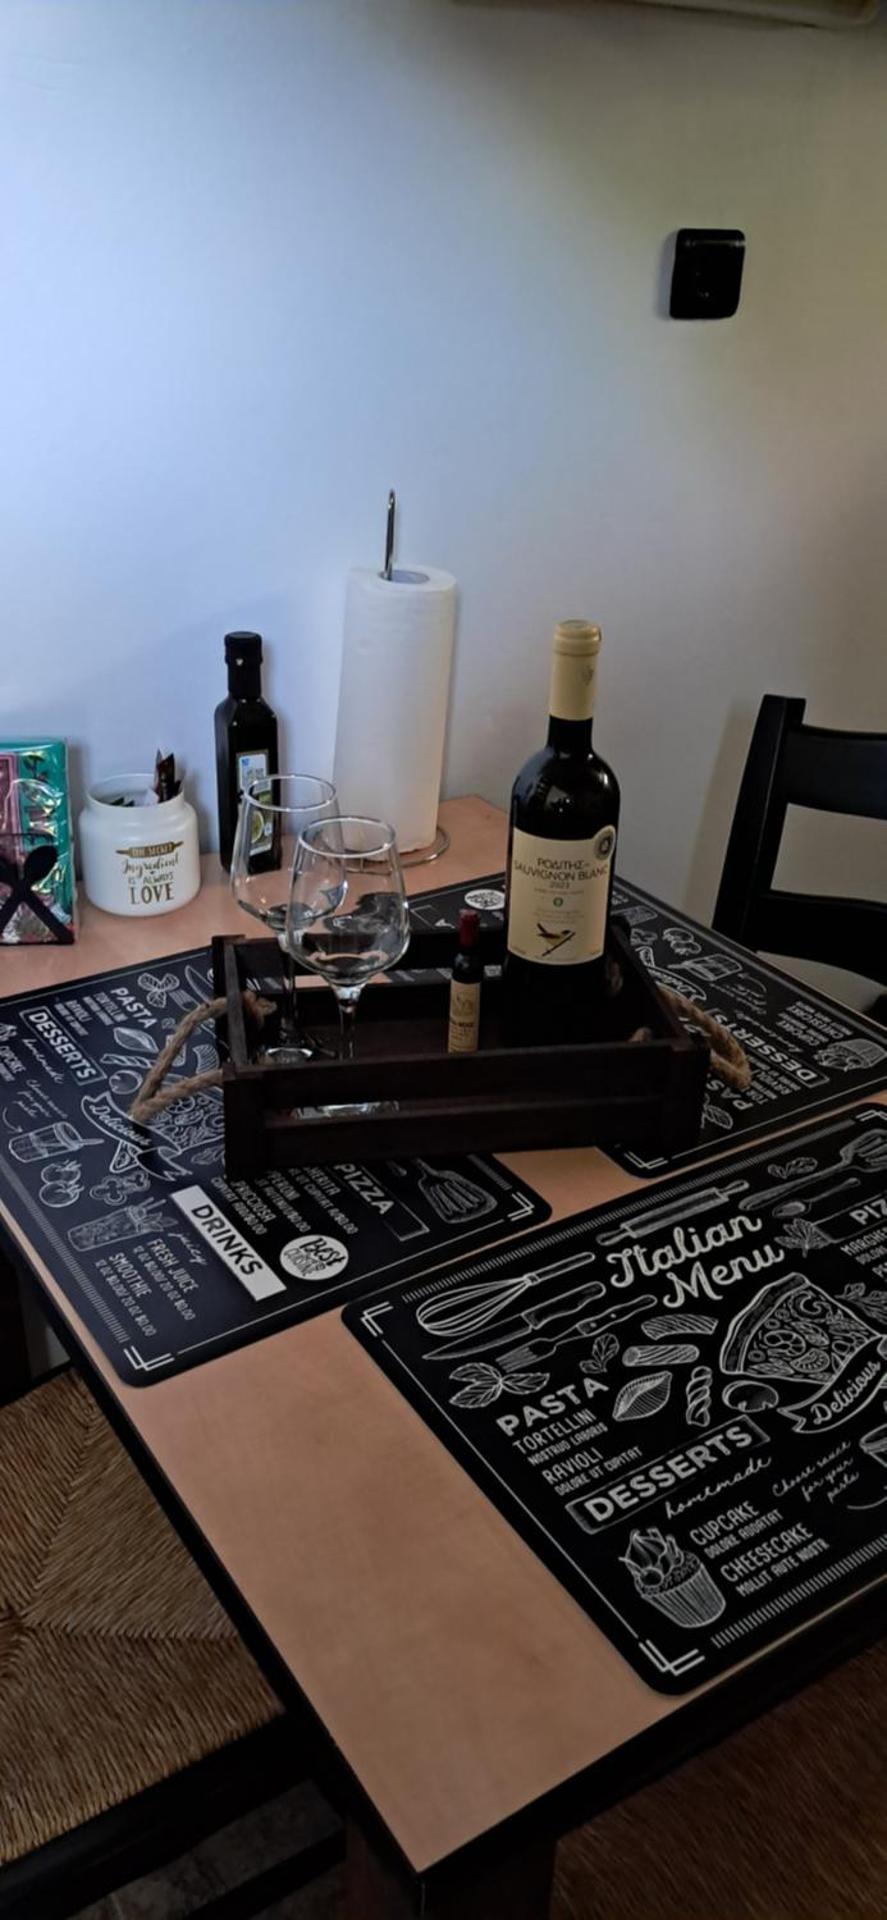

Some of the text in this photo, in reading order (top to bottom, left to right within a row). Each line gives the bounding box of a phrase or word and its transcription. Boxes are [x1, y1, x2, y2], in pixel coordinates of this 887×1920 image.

[130, 882, 174, 905] LOVE
[143, 872, 174, 884] ALWAYS
[514, 860, 608, 881] SAUVIGNON BLANC
[110, 987, 157, 1029] PASTA
[29, 1012, 97, 1080] DESSERTS
[714, 1014, 818, 1081] DESSERTS
[706, 1077, 755, 1110] PAS
[89, 1103, 151, 1147] Delicious
[333, 1163, 394, 1215] PIZZA
[850, 1198, 887, 1225] PIZ
[190, 1204, 264, 1276] DRINKS
[606, 1215, 762, 1288] Italian
[109, 1252, 152, 1298] SMOOTHIE
[147, 1238, 199, 1293] FRESH JUICE
[663, 1244, 785, 1308] Menu
[496, 1377, 610, 1437] PASTA
[810, 1360, 881, 1425] Delicious
[512, 1408, 597, 1455] TORTELLINI
[541, 1446, 604, 1485] RAVIOLI
[553, 1472, 592, 1497] DOLORE
[588, 1465, 605, 1479] UT
[583, 1424, 754, 1523] DESSERTS
[664, 1456, 772, 1520] homemade
[771, 1465, 816, 1497] Choose
[801, 1456, 855, 1502] for your
[689, 1500, 760, 1546] CUPCAKE
[719, 1521, 814, 1583] CHEESECAKE
